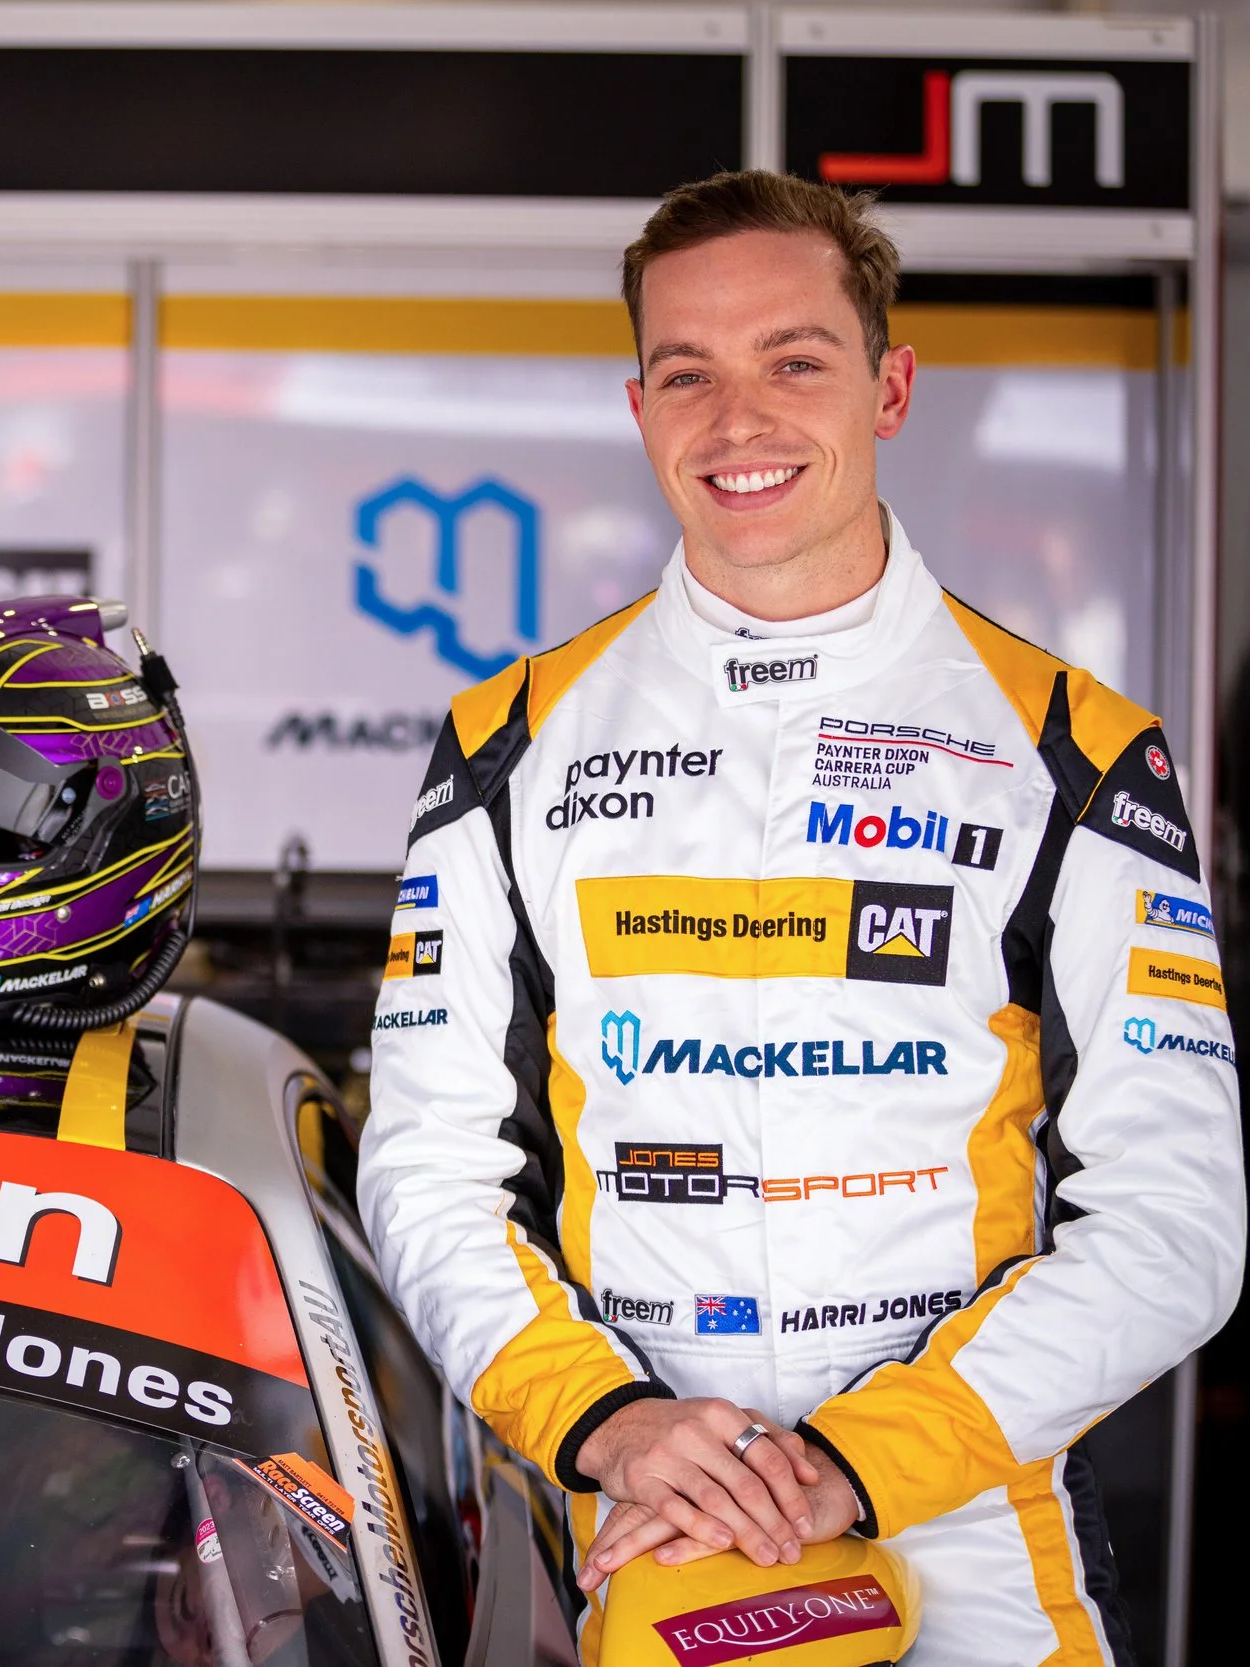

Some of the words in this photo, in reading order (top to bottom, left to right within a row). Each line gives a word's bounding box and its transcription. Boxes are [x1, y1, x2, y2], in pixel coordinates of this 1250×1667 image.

[725, 658, 817, 689] freem
[819, 716, 996, 757] PORSCHE
[566, 743, 723, 793] paynter
[814, 758, 882, 775] CARRERA
[885, 763, 915, 775] CUP
[816, 742, 881, 760] PAYNTER
[885, 748, 930, 764] DIXON
[812, 773, 892, 790] AUSTRALIA
[545, 790, 653, 832] dixon
[1112, 791, 1187, 852] freem
[806, 801, 949, 853] Mobil
[971, 828, 987, 865] 1
[615, 909, 727, 940] Hastings
[732, 911, 827, 943] Deering
[0, 964, 88, 993] MACKELLAR
[1148, 964, 1191, 985] Hastings
[642, 1038, 949, 1078] MACKELLAR
[619, 1148, 719, 1167] JONES
[601, 1288, 674, 1325] freem
[780, 1302, 866, 1334] HARRI
[872, 1289, 963, 1323] JONES
[298, 1504, 316, 1519] TEAR
[198, 1520, 216, 1537] 2023
